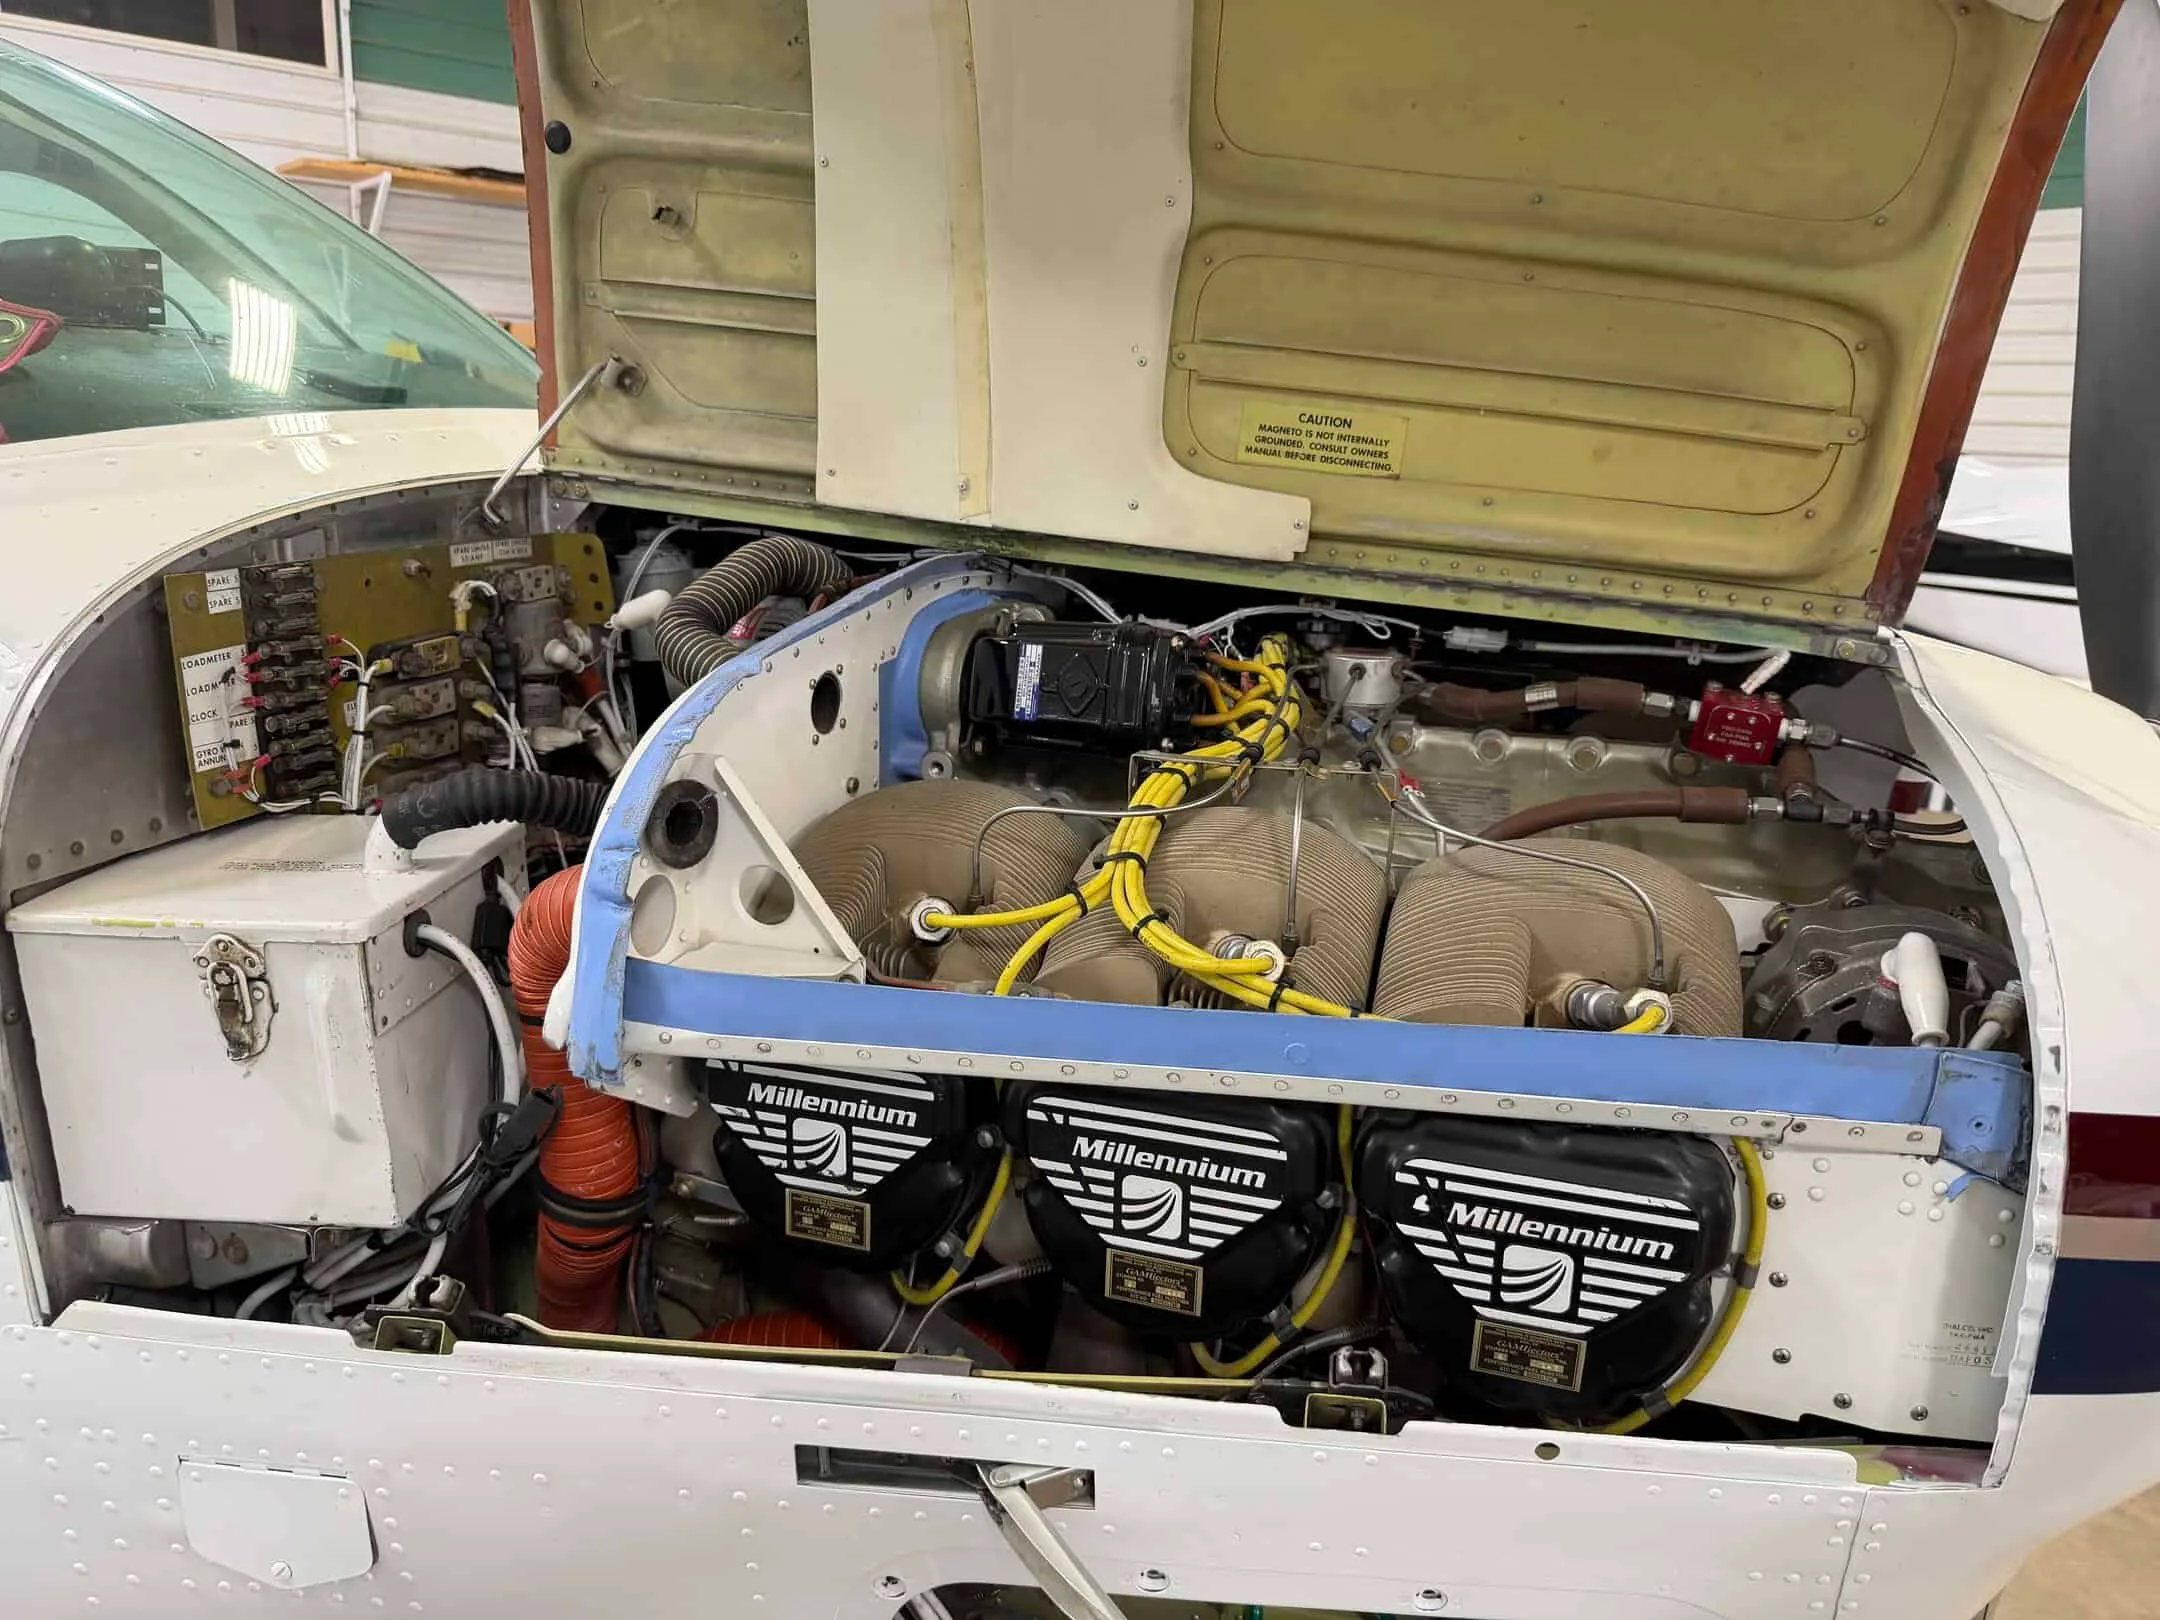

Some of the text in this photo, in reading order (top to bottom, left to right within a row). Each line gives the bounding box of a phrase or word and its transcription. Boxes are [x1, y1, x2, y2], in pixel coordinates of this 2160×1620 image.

[1298, 412, 1352, 429] CAUTION
[1258, 423, 1390, 447] MAGNETO IS NOT INTERNALLY
[1254, 435, 1389, 460] GROUNDED. CONSULT OWNERS
[1245, 445, 1394, 472] MANUAL BEFORE DISCONNECTING.
[207, 576, 231, 587] SPARE
[208, 597, 233, 609] SPARE
[182, 651, 232, 670] LOADMETER
[186, 677, 236, 697] LOADMER
[190, 709, 218, 723] CLOCK
[228, 717, 249, 729] PARE
[195, 747, 218, 760] GYRO
[747, 1082, 917, 1128] Millennium
[1072, 1136, 1267, 1189] Millennium
[1447, 1202, 1676, 1261] Millennium
